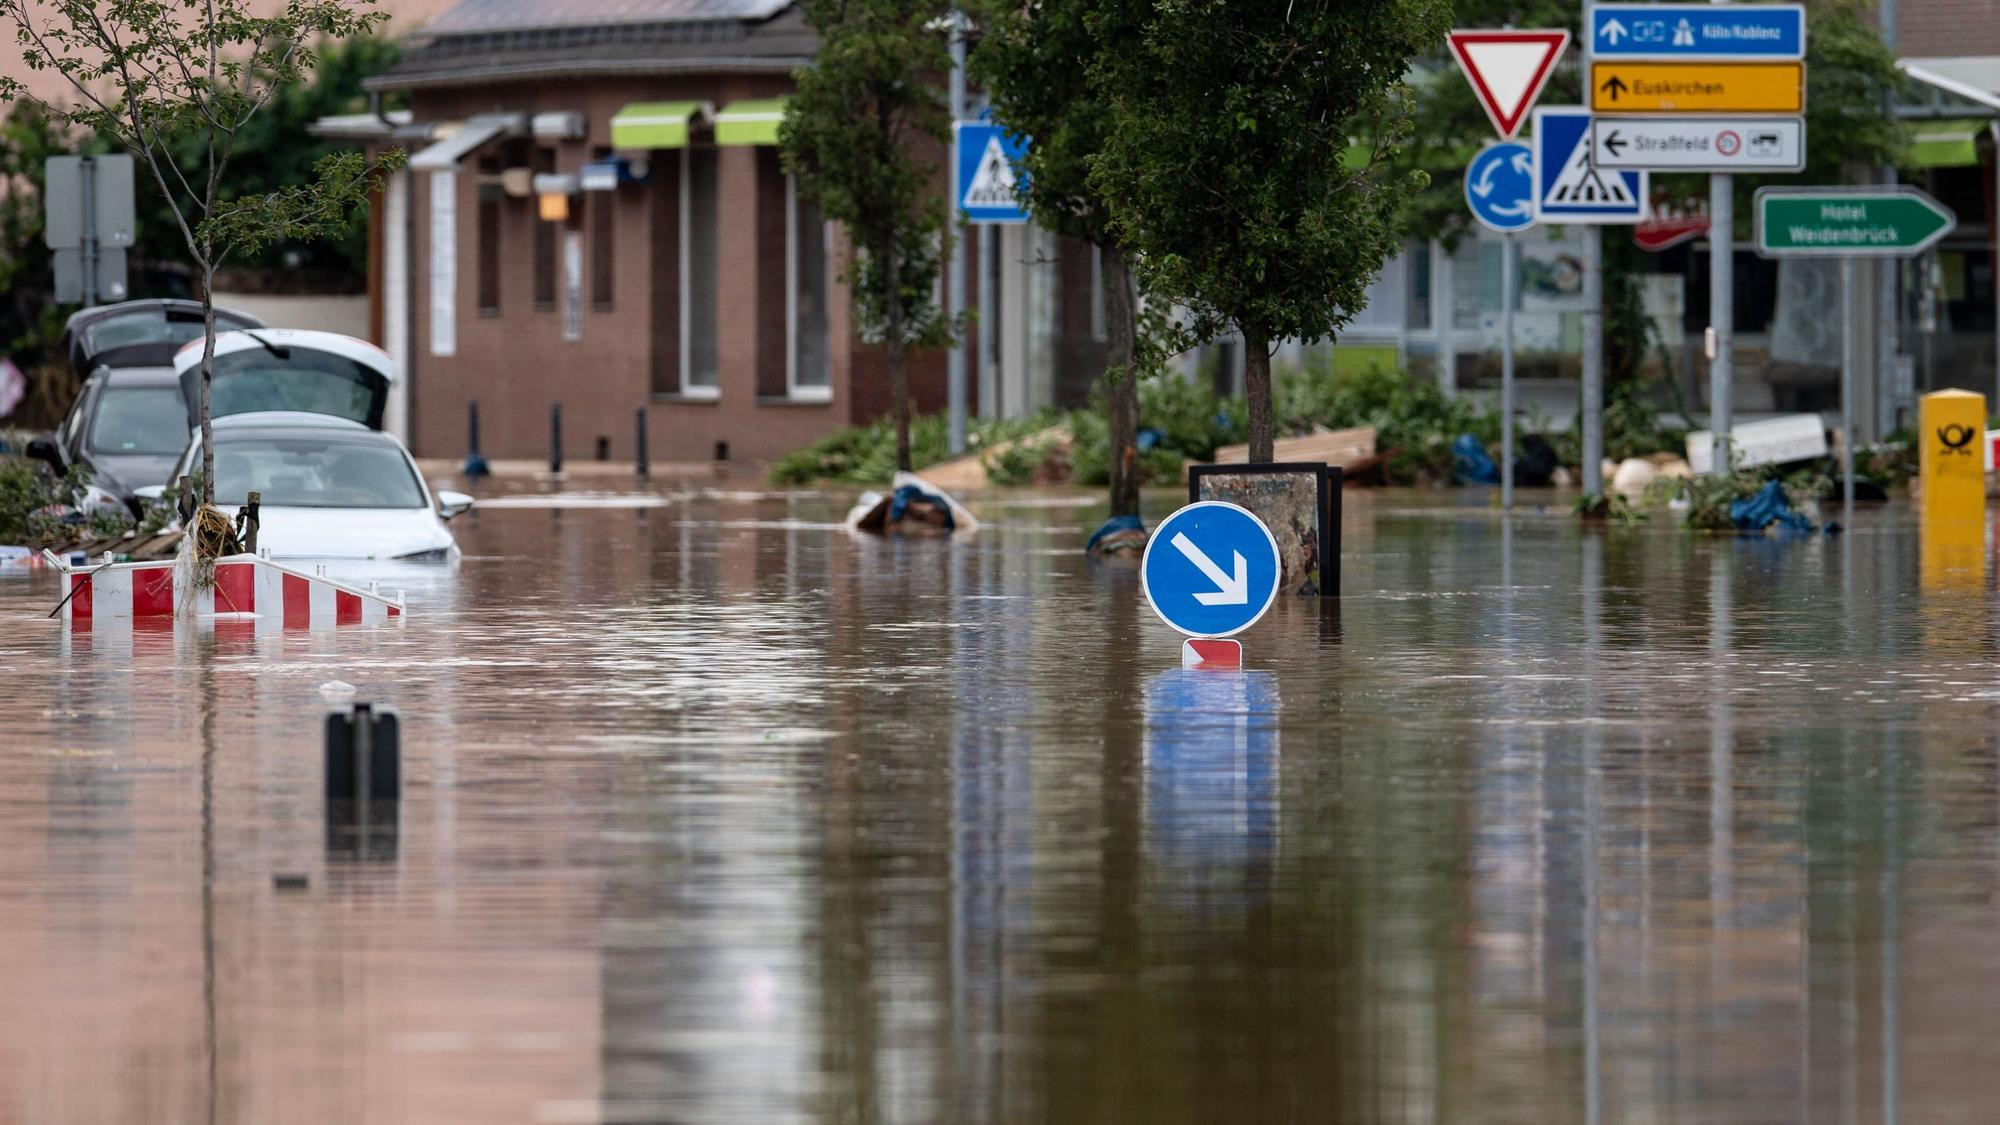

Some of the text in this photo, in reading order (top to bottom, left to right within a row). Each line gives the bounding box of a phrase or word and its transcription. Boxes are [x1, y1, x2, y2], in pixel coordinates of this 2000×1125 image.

[1633, 80, 1724, 95] Euskirchen
[1635, 136, 1709, 151] Straßfeld
[1821, 204, 1866, 220] Hotel
[1790, 227, 1897, 243] Weidenbrück
